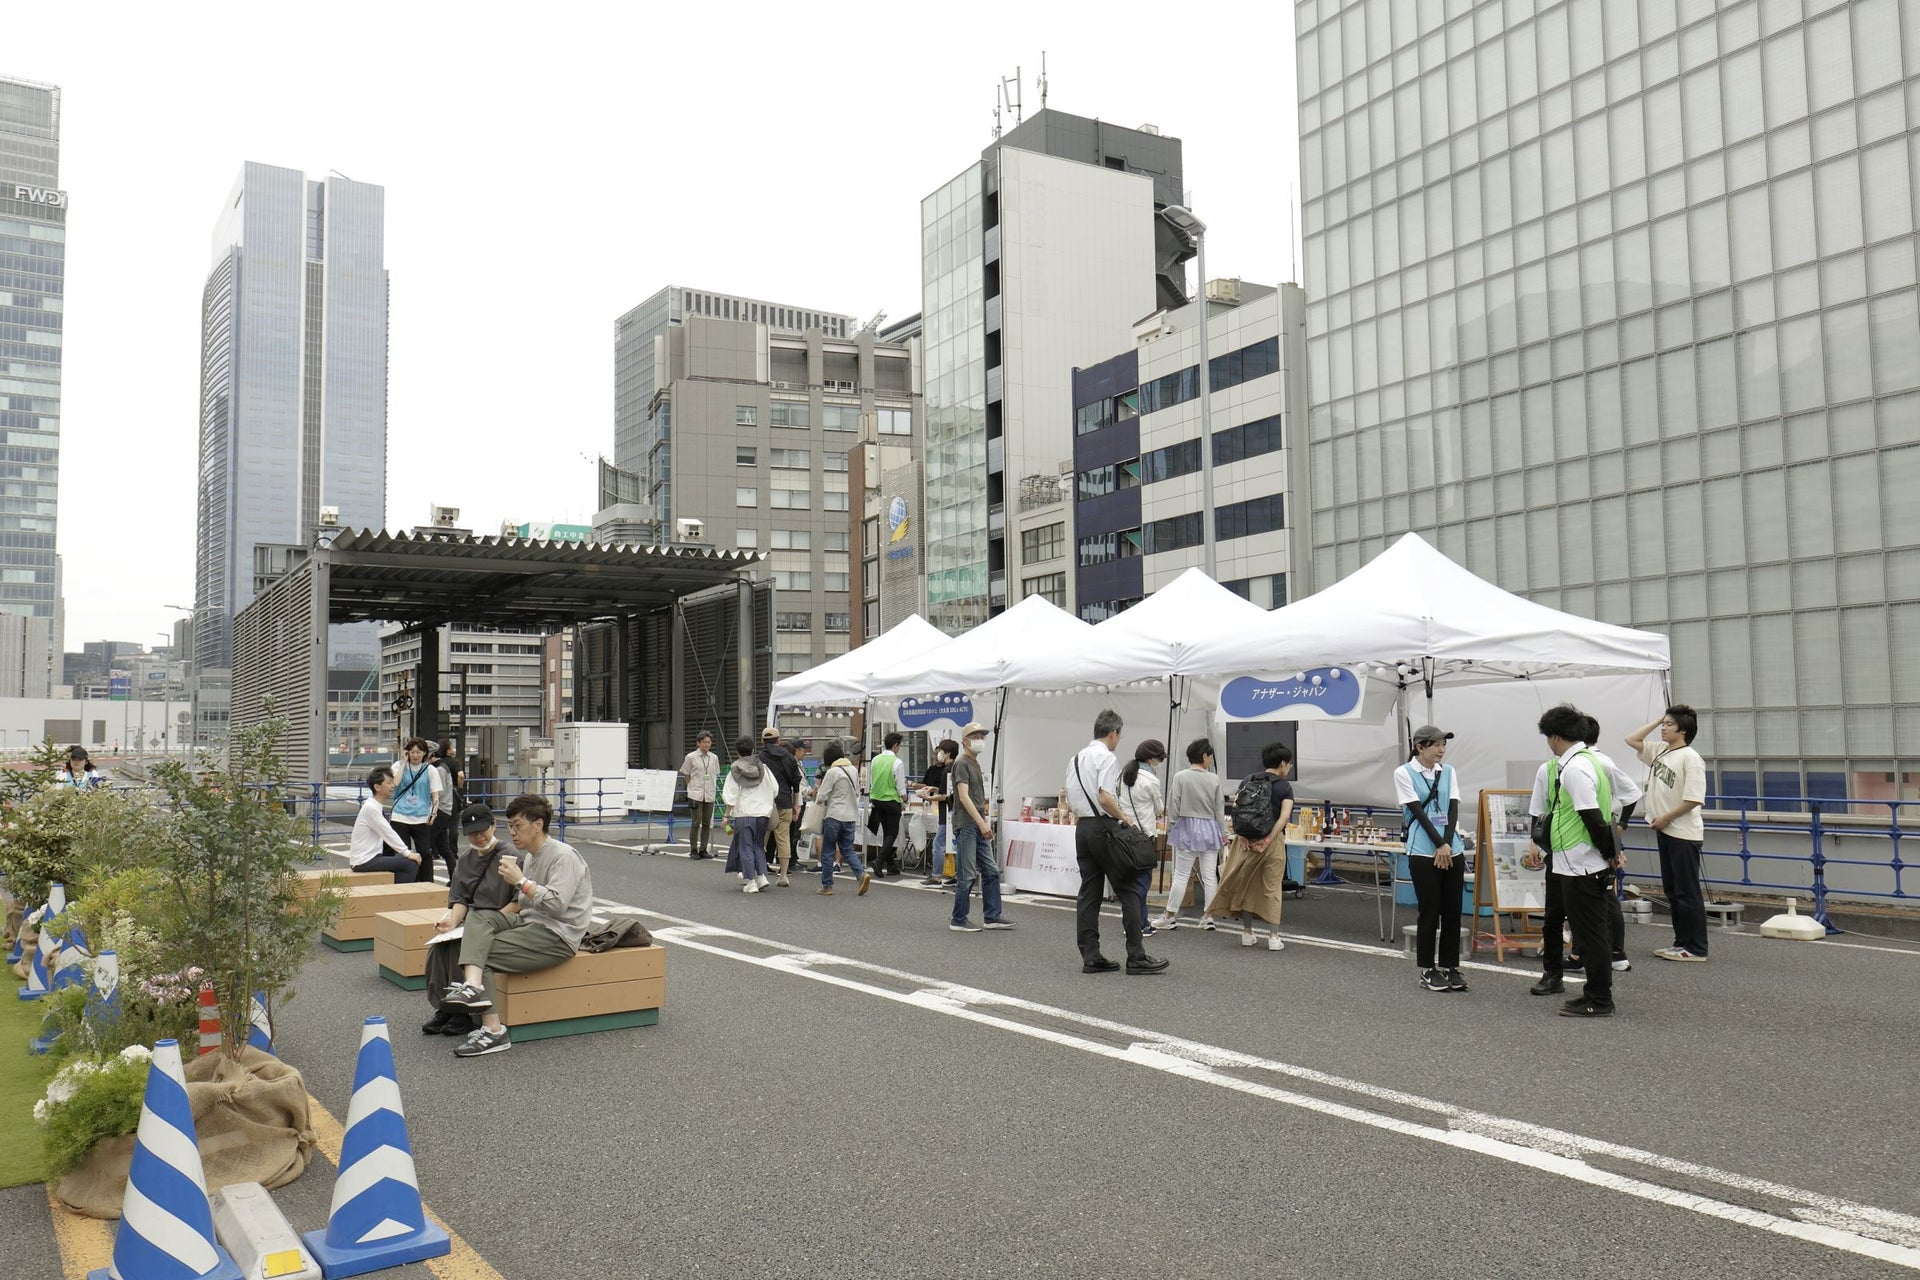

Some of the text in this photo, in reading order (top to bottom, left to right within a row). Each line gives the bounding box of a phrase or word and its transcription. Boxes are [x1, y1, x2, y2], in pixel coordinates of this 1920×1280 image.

[15, 186, 61, 206] FWD
[1252, 686, 1327, 700] アナザー・ジャパン
